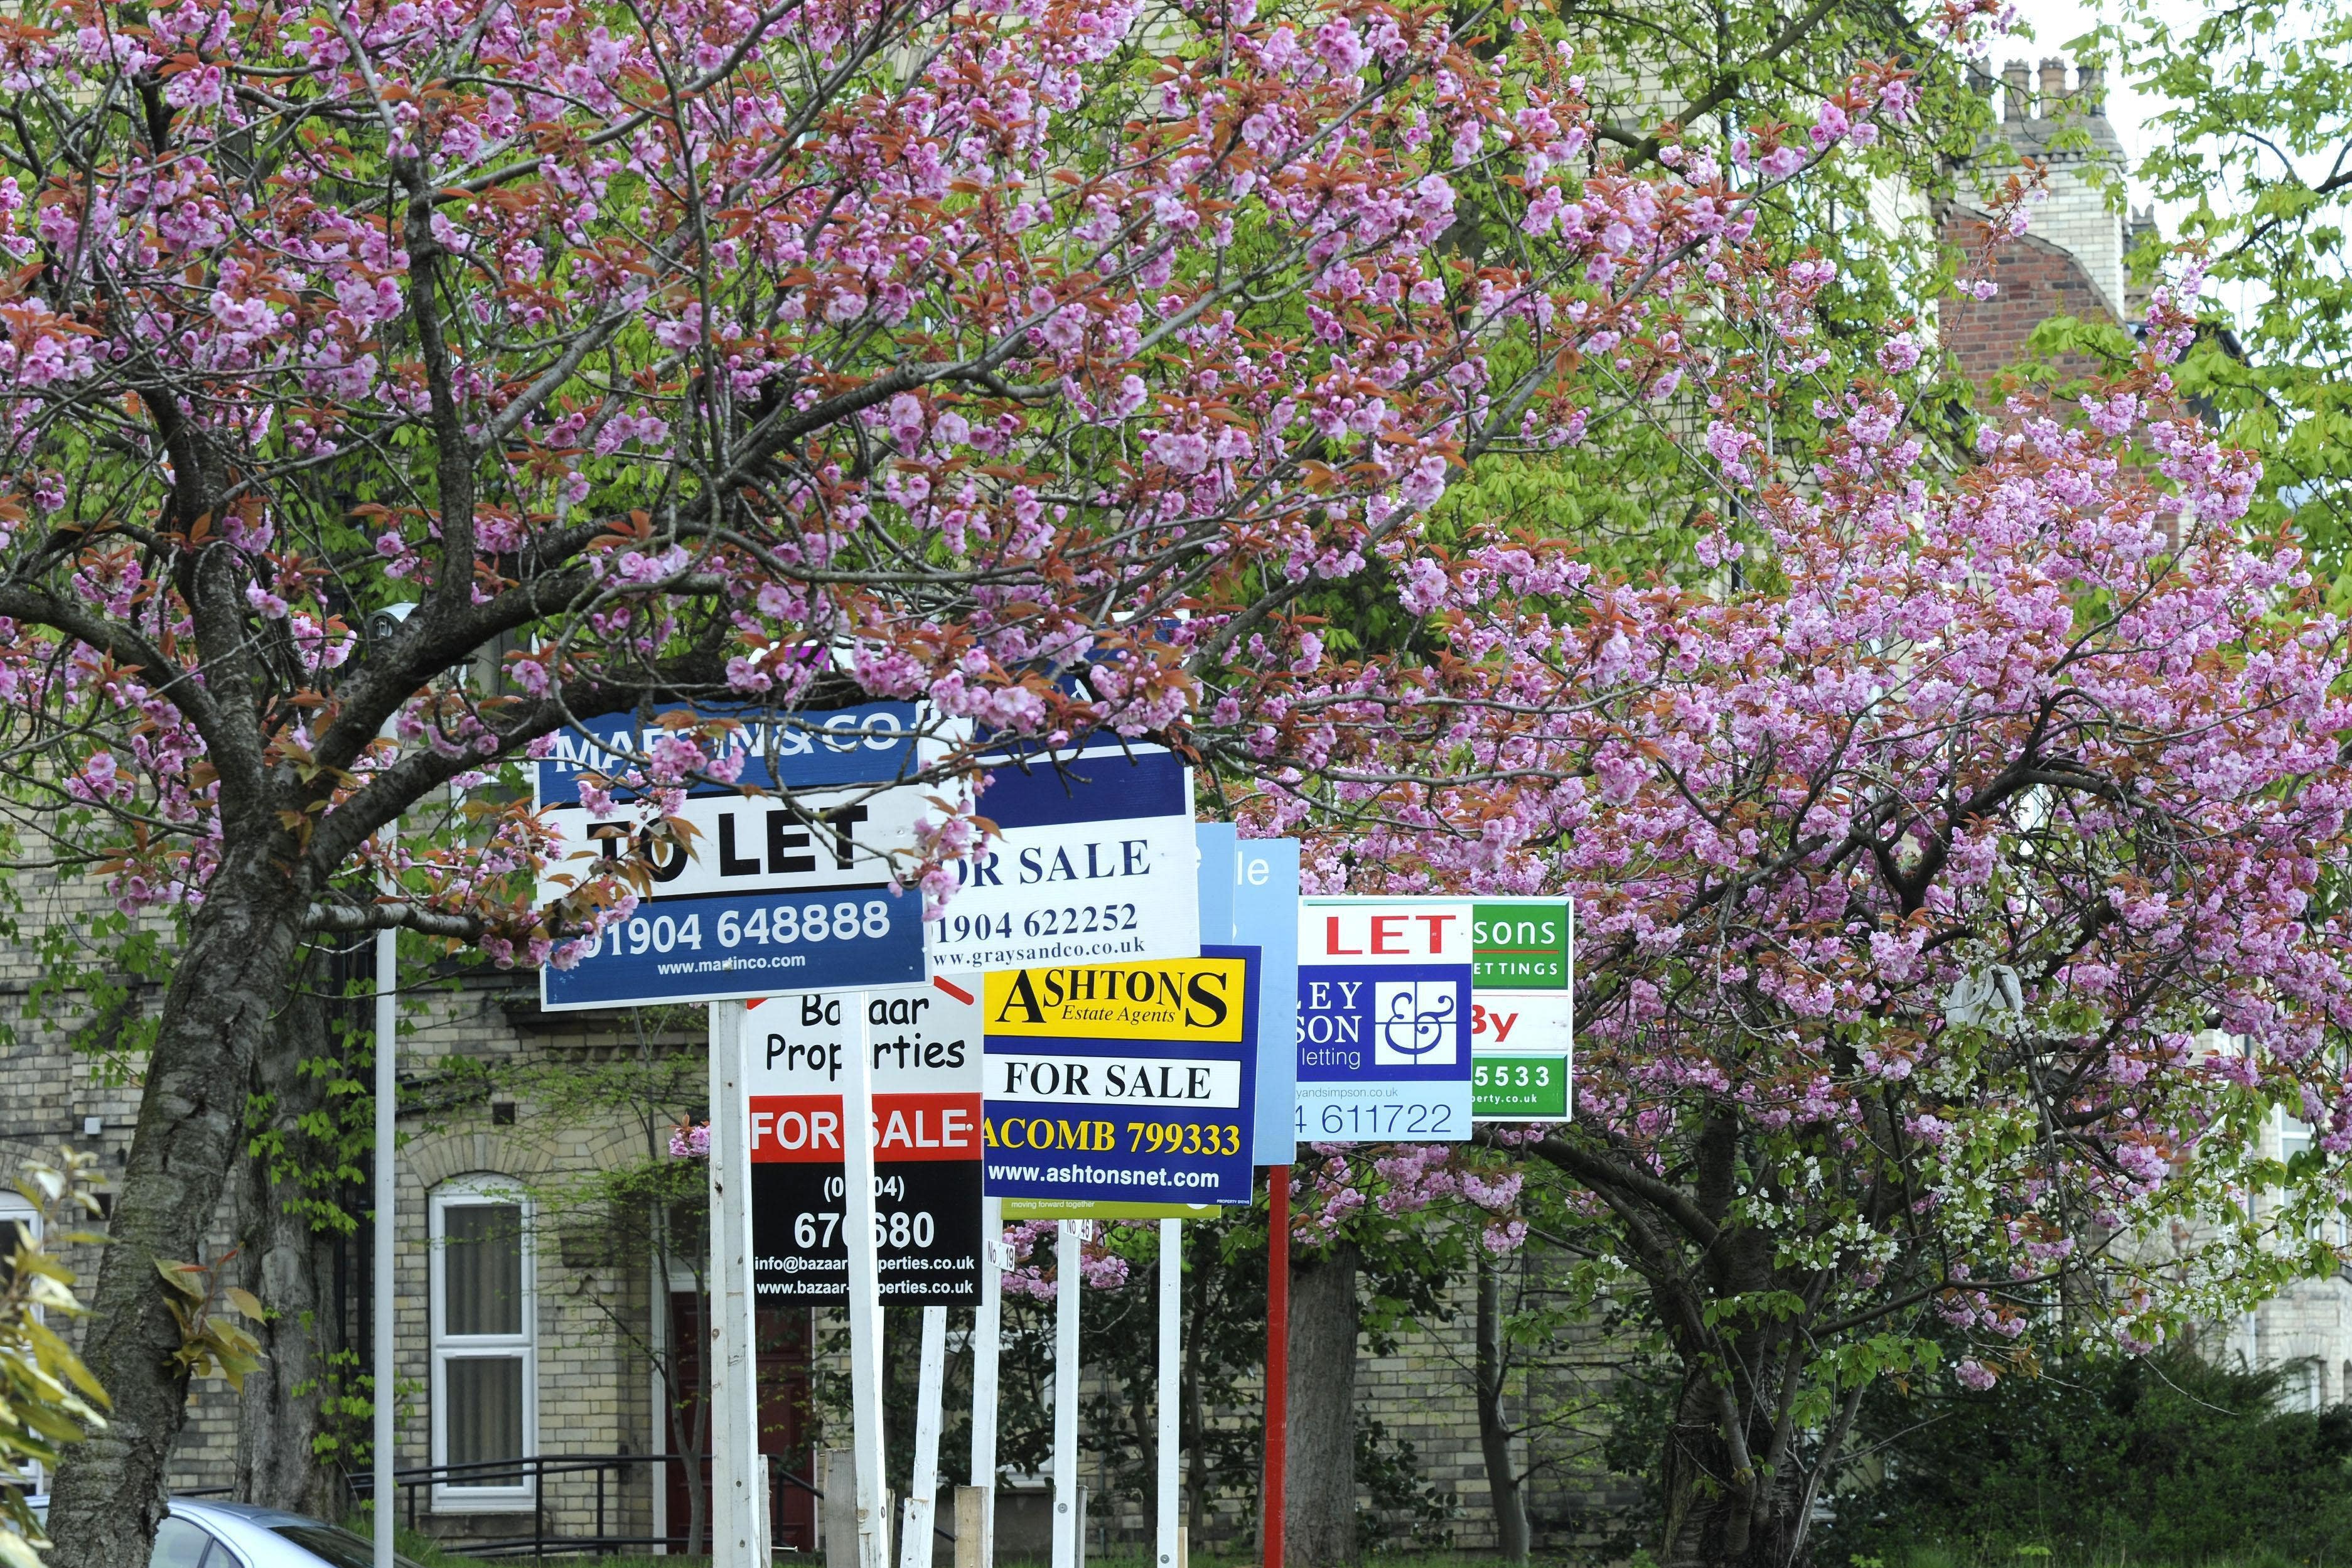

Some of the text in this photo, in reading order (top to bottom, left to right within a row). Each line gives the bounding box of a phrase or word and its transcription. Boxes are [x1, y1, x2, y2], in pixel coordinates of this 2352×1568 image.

[586, 805, 868, 883] TO LET
[1019, 839, 1151, 885] SALE
[717, 900, 890, 948] 648888
[932, 903, 1138, 943] 1904 622252
[1326, 915, 1456, 955] LET
[1473, 921, 1555, 945] sons
[802, 994, 929, 1026] Baaar
[994, 969, 1228, 1028] ASHTONS
[1061, 1005, 1176, 1026] Estate Agents
[767, 1033, 965, 1082] Proprties
[1302, 1048, 1360, 1070] letting
[1003, 1061, 1211, 1099] FOR SALE
[1474, 1066, 1550, 1087] 5533
[1296, 1087, 1399, 1099] yandsimpson.co.uk
[751, 1109, 969, 1150] FOR ALE
[1321, 1104, 1451, 1134] 611722
[983, 1117, 1241, 1156] ACOMB 799333
[824, 1176, 905, 1203] (004)
[988, 1163, 1220, 1188] www.ashtonsnet.com
[1011, 1201, 1036, 1210] moving
[1066, 1201, 1095, 1210] together
[987, 1240, 1014, 1269] No 19
